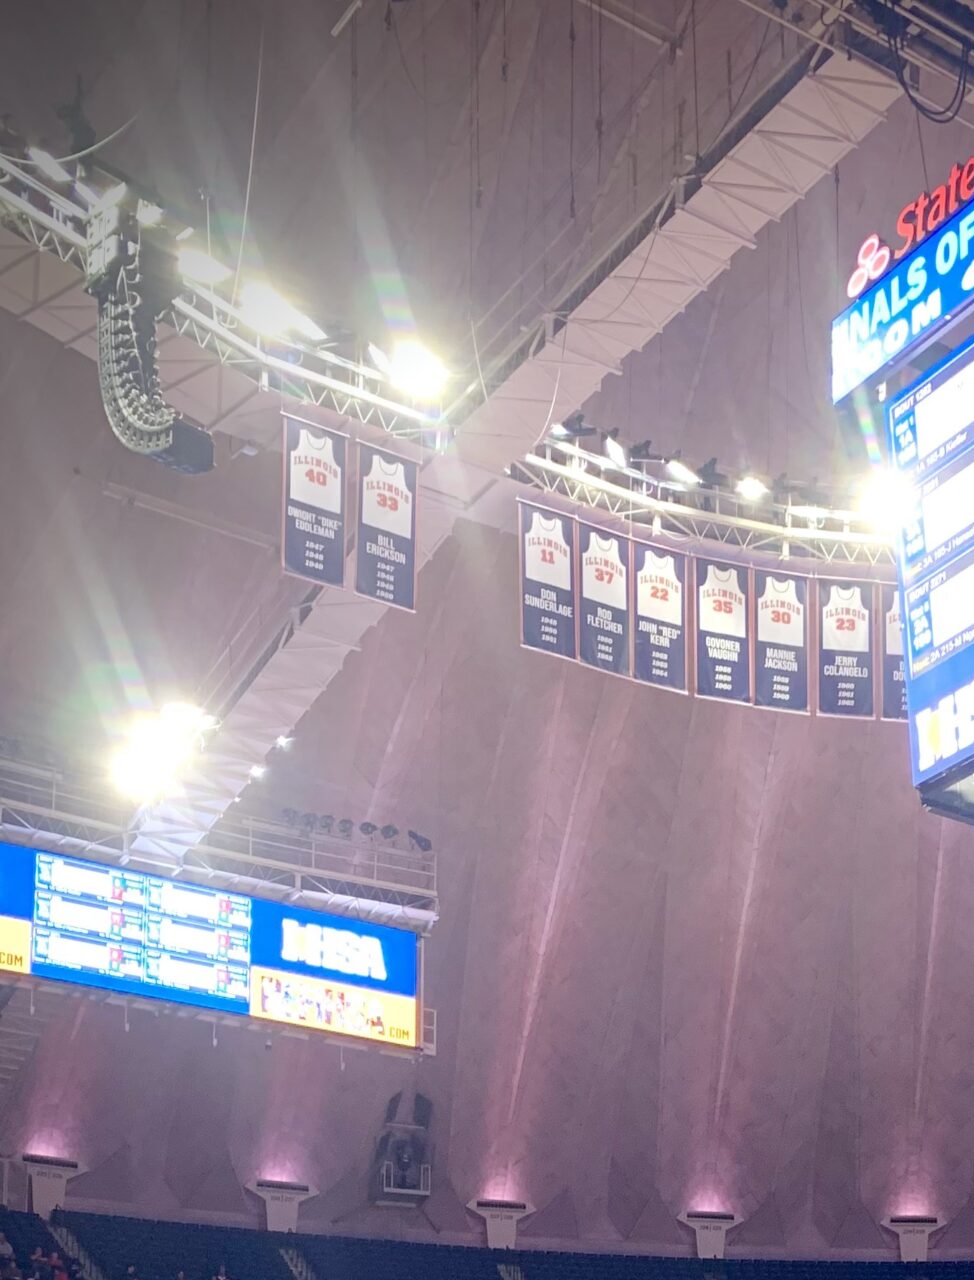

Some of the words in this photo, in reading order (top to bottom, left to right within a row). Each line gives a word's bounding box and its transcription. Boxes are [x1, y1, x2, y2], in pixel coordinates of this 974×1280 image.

[293, 455, 339, 480] ILLINOIS
[305, 468, 328, 487] 40
[365, 481, 410, 505] ILLINOIS
[376, 492, 399, 512] 33
[377, 534, 396, 551] BILL
[528, 536, 568, 558] ILLINOIS
[366, 541, 406, 566] ERICKSON
[540, 549, 556, 565] 11
[585, 556, 624, 578] ILLINOIS
[594, 568, 615, 585] 37
[540, 587, 557, 602] DON
[650, 585, 670, 602] 22
[702, 587, 743, 606] ILLINOIS
[524, 594, 573, 619] SUNDERLAGE
[712, 599, 734, 615] 35
[760, 599, 801, 616] ILLINOIS
[825, 606, 867, 622] ILLINOIS
[587, 614, 623, 635] FLETCHER
[771, 610, 792, 625] 30
[835, 617, 857, 632] 23
[638, 619, 658, 634] JOHN
[650, 634, 671, 649] KERR
[708, 647, 739, 663] VAUGHN
[766, 647, 796, 662] MANNIE
[834, 655, 858, 667] JERRY
[764, 657, 798, 673] JACKSON
[823, 664, 869, 679] COLANGELO
